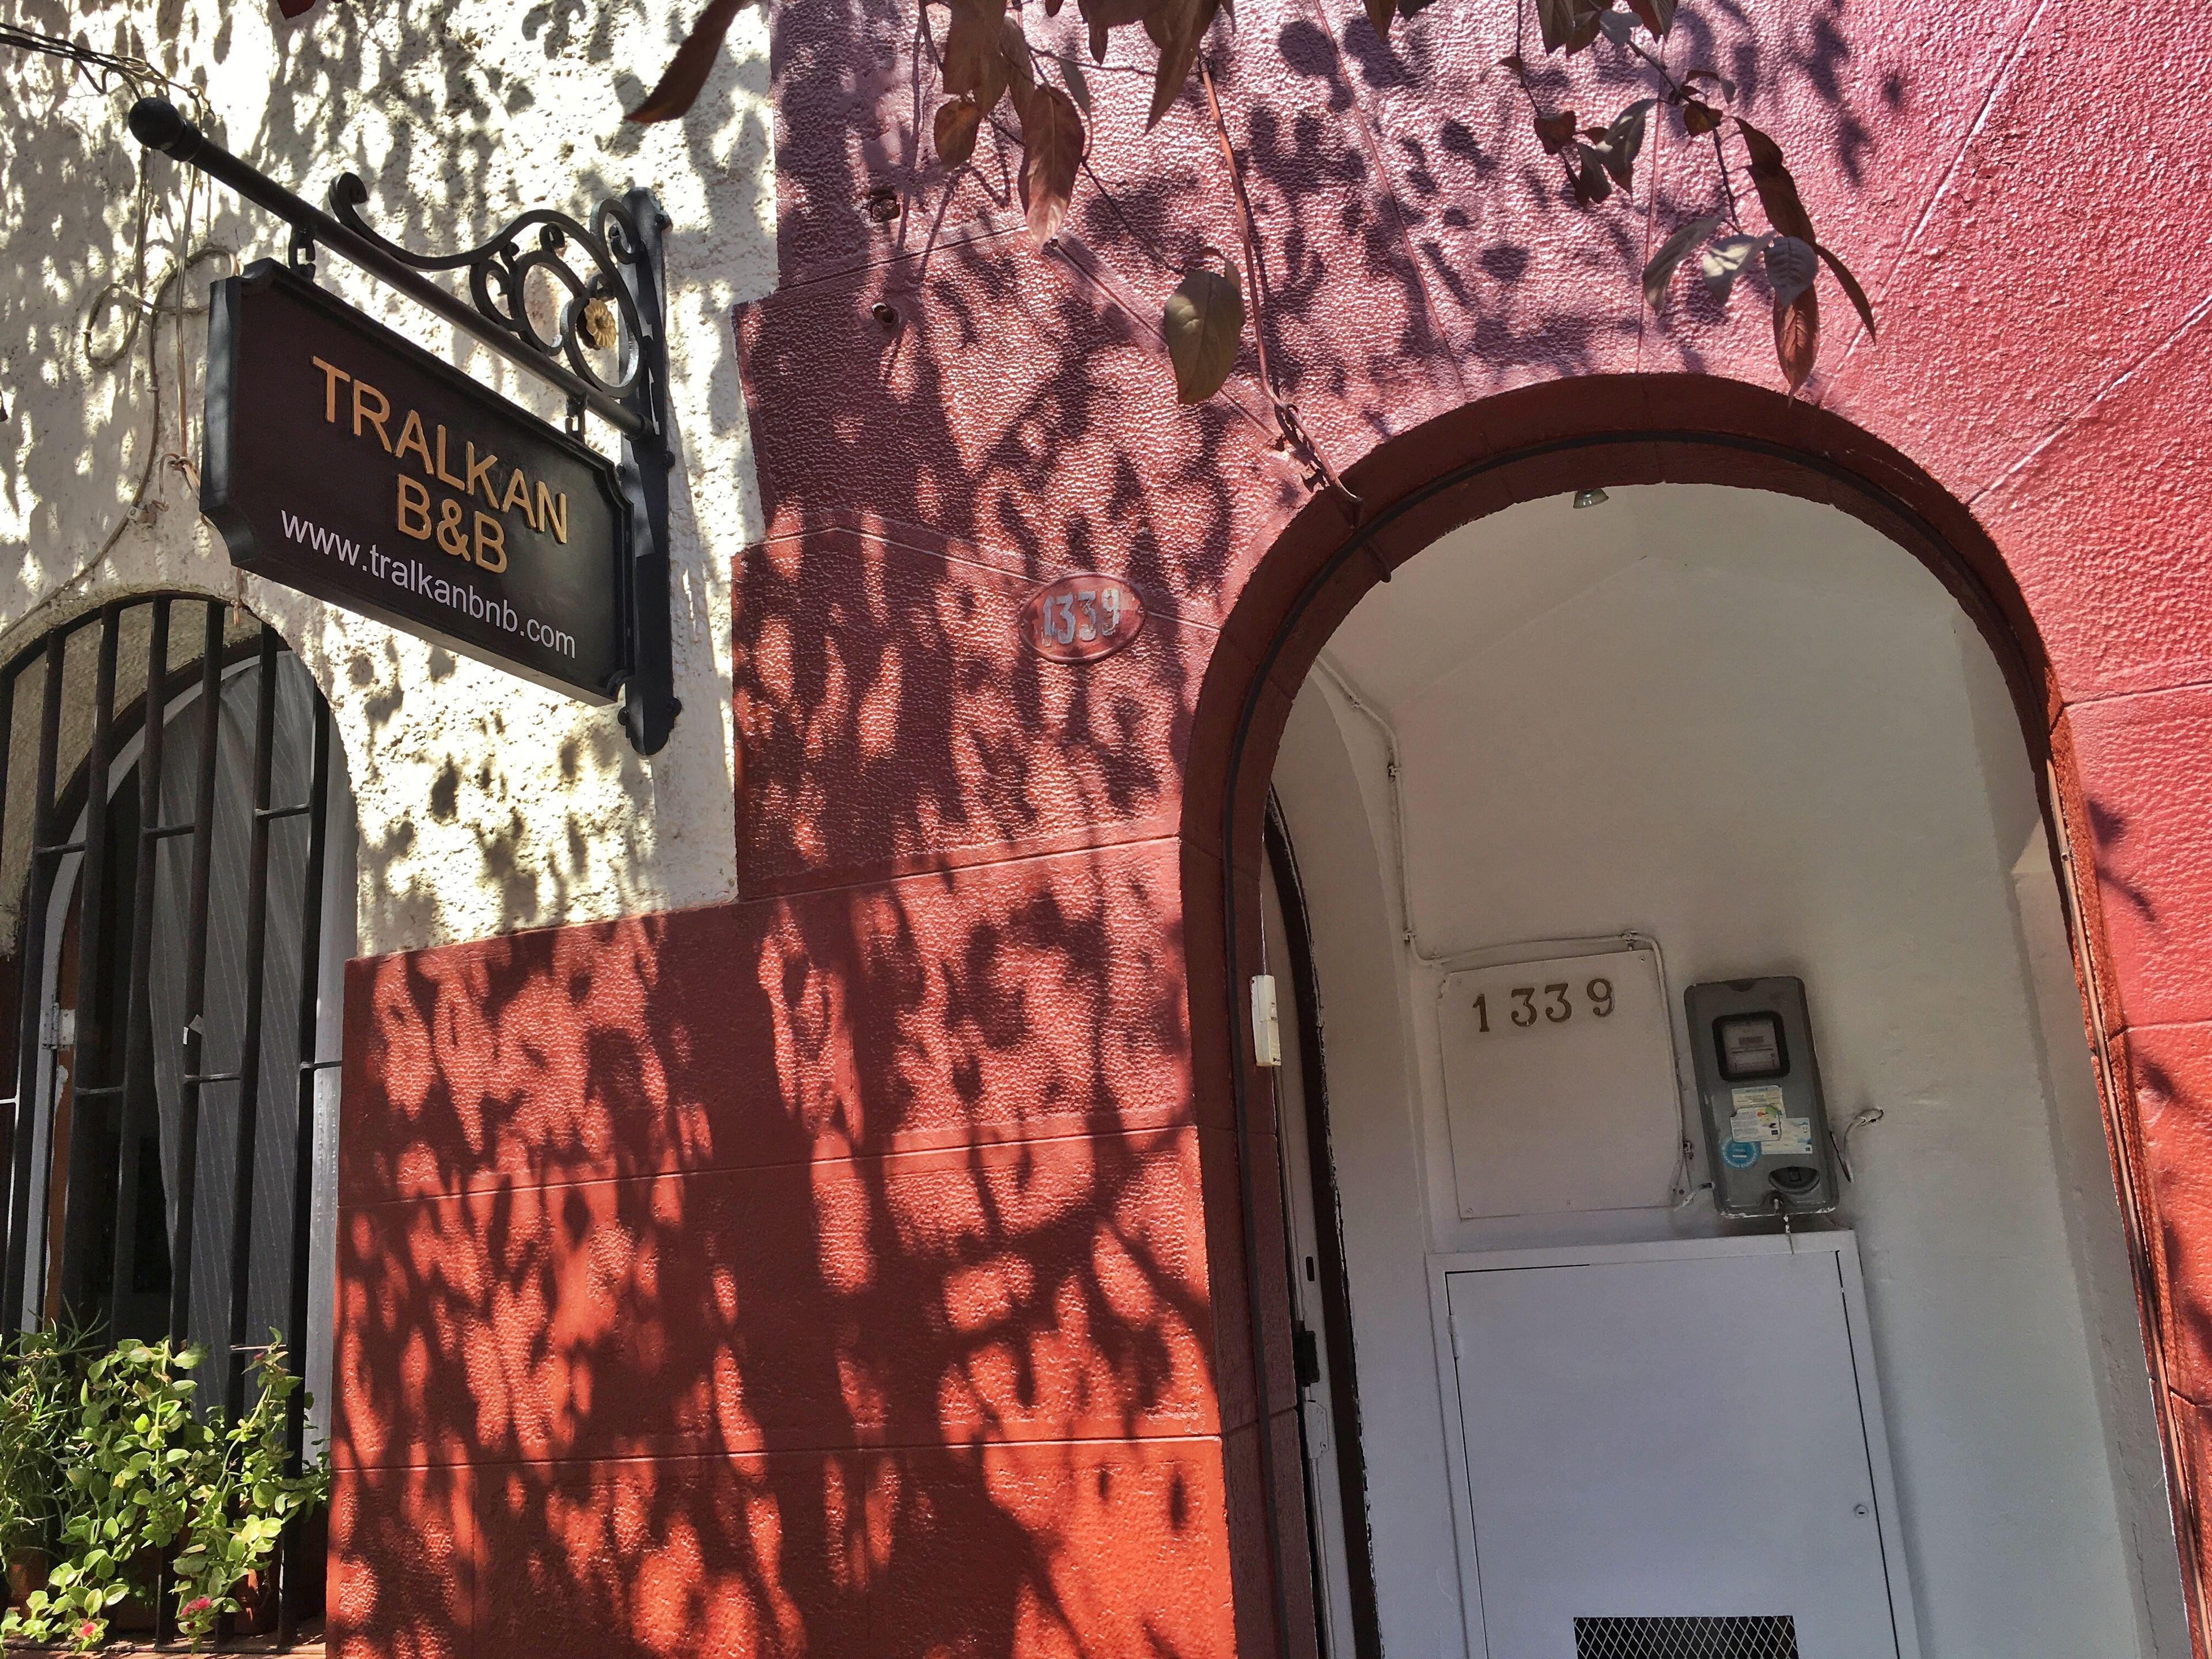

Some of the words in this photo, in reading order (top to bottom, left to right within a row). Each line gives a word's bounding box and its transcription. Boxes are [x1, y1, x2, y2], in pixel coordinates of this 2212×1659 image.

[312, 356, 567, 544] TRALKAN
[397, 474, 507, 573] B&B
[281, 510, 575, 658] www.tralkanbnb.com
[1042, 589, 1120, 646] 1339
[1473, 978, 1615, 1032] 1339
